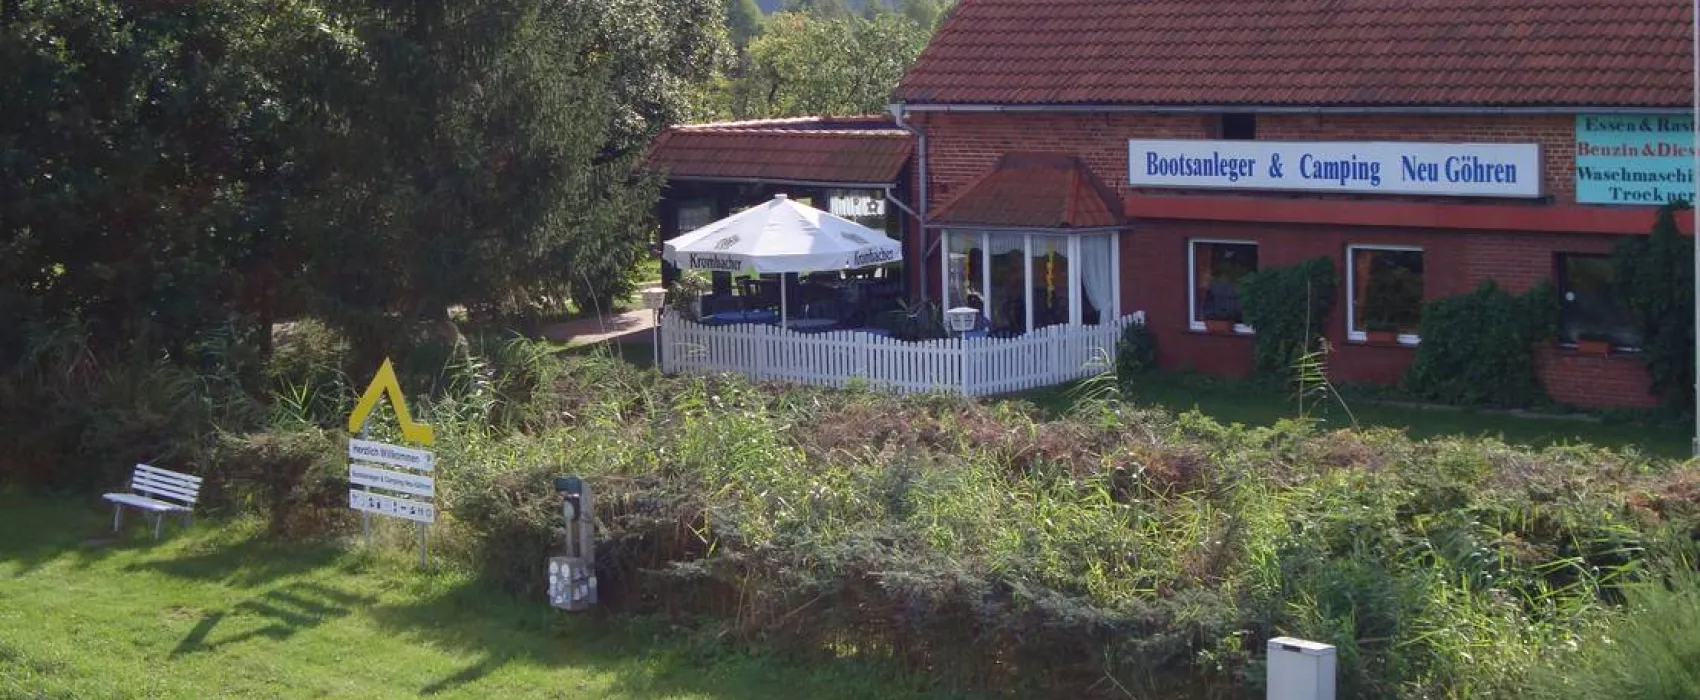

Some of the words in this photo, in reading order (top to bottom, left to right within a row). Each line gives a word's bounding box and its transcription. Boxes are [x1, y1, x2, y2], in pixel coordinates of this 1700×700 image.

[1584, 116, 1637, 132] Essen
[1640, 117, 1652, 132] &
[1578, 141, 1638, 156] Benzin
[1146, 151, 1256, 182] Bootsanleger
[1269, 152, 1284, 178] &
[1300, 153, 1381, 187] Camping
[1401, 155, 1439, 183] Neu
[1445, 154, 1517, 184] Göhren
[1577, 166, 1694, 182] Waschmaschi
[690, 252, 742, 272] Krombacher
[854, 245, 894, 266] Krombacher
